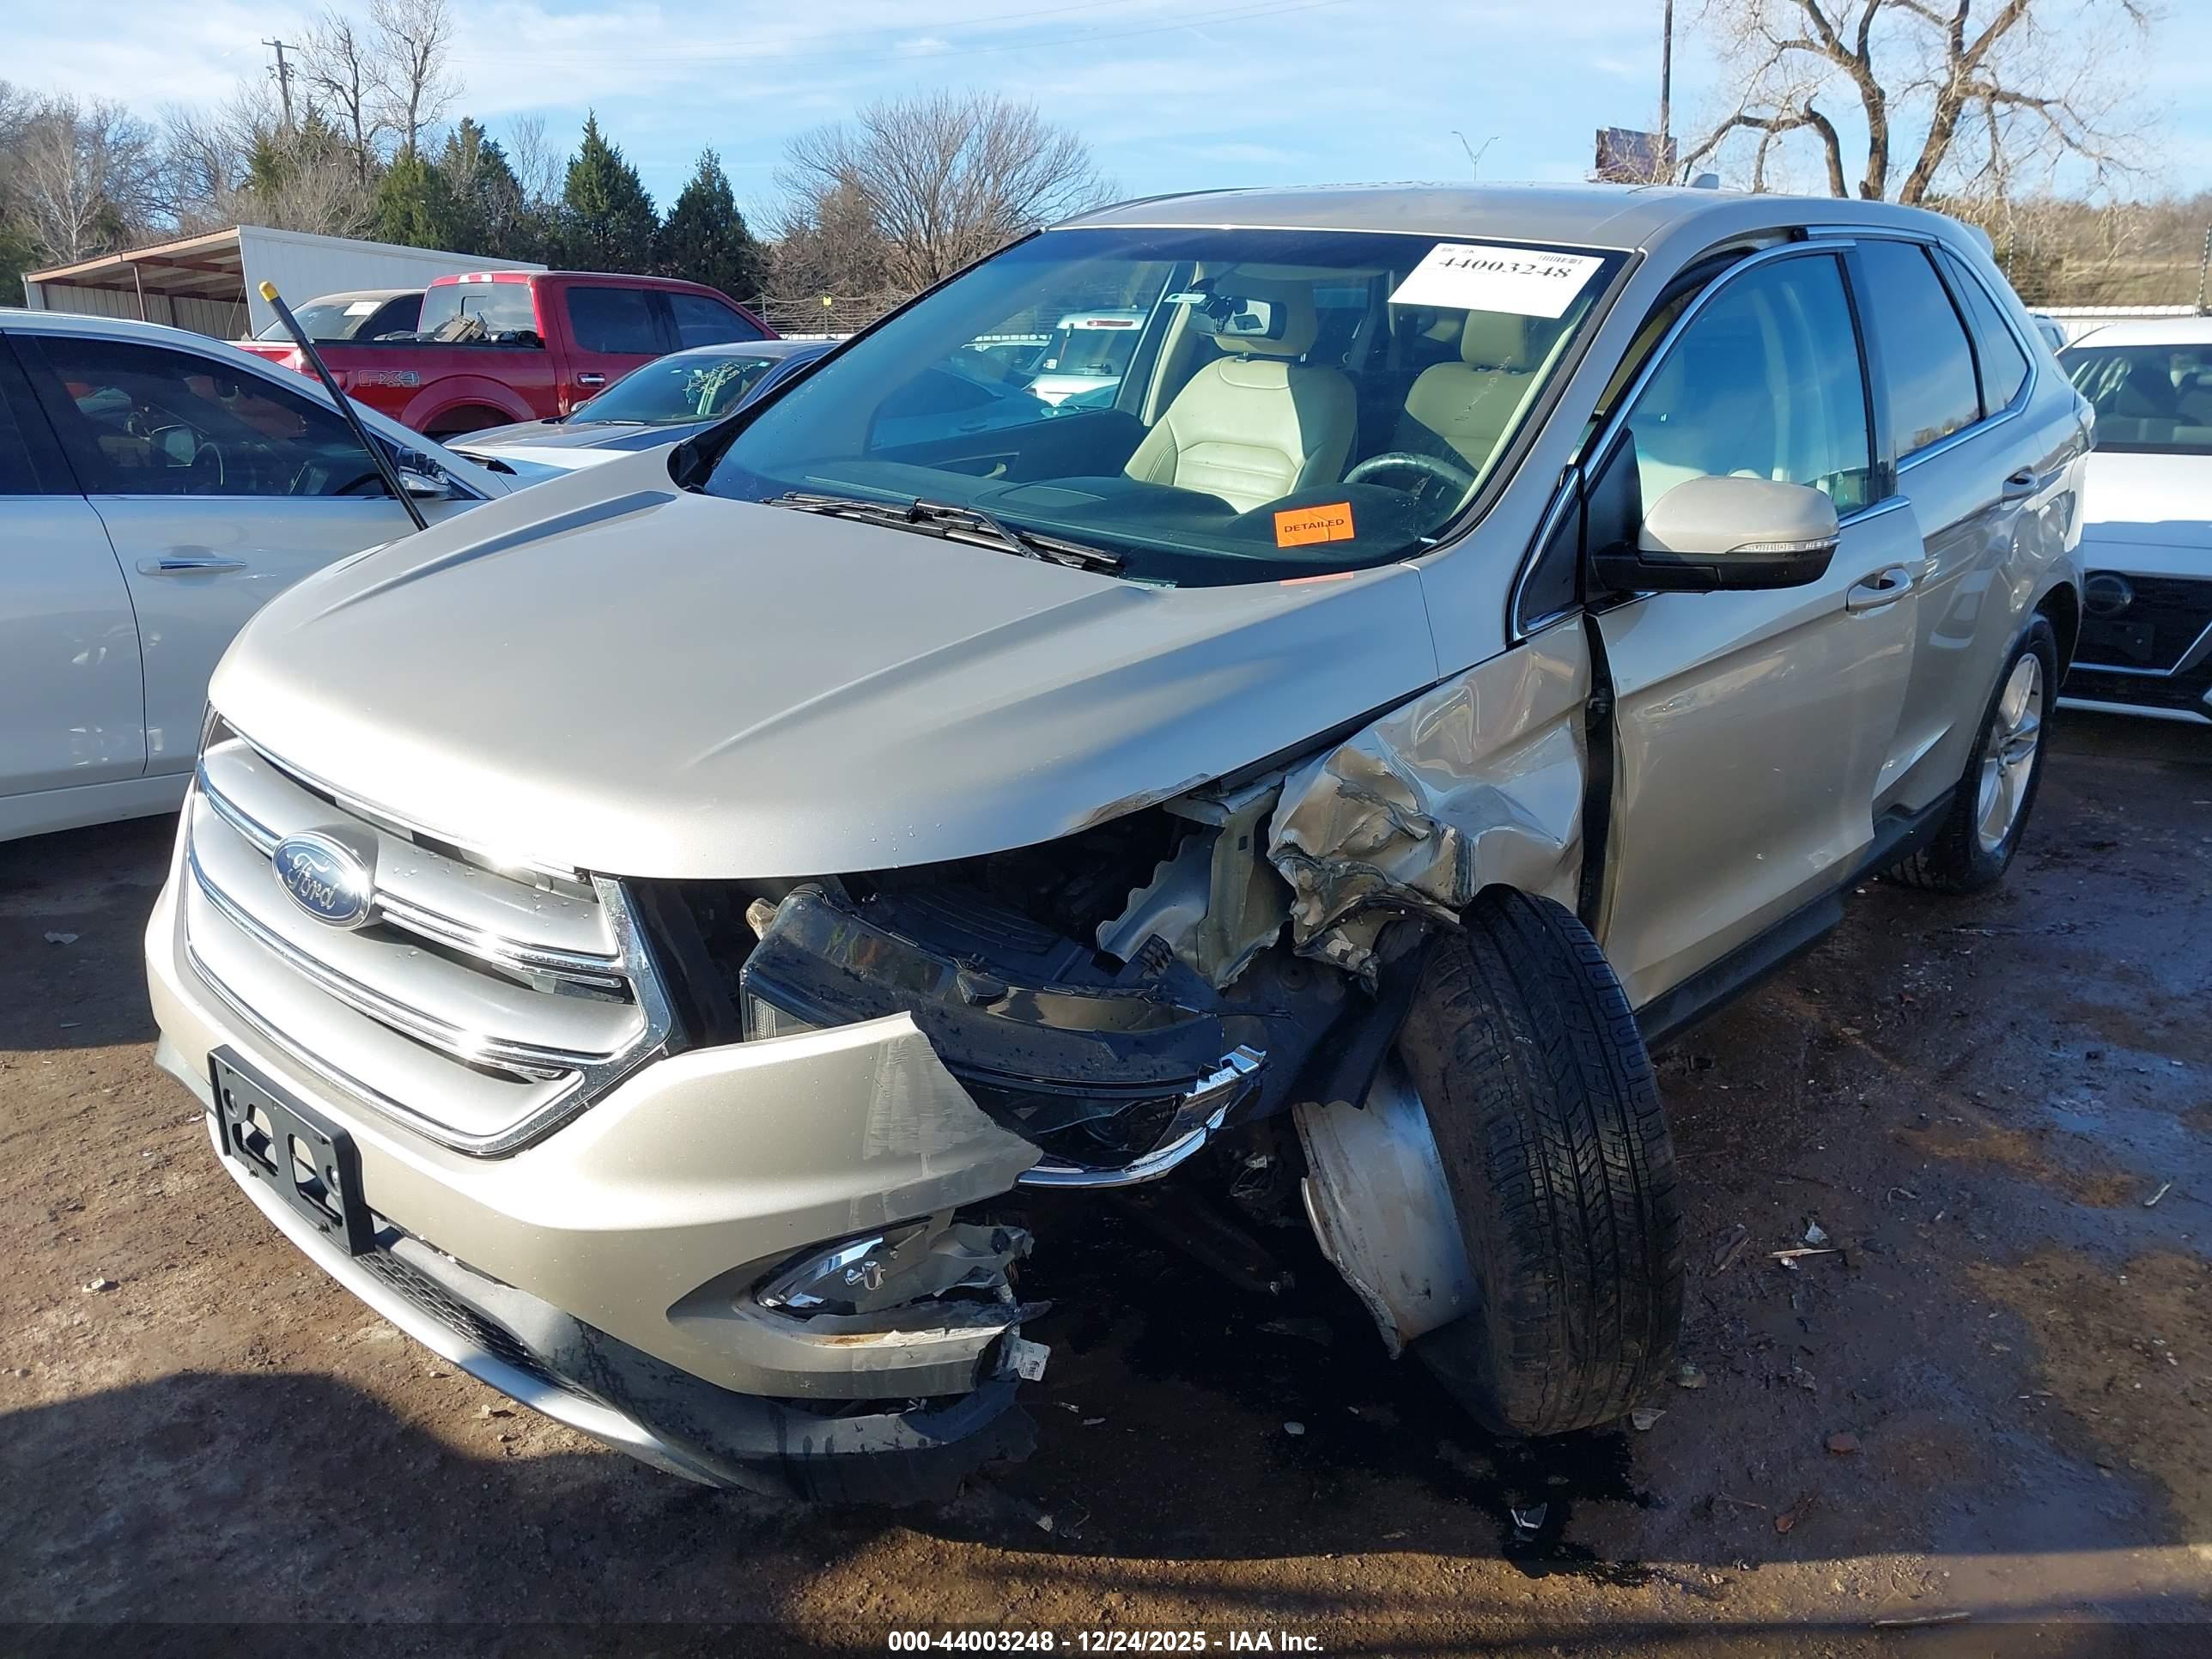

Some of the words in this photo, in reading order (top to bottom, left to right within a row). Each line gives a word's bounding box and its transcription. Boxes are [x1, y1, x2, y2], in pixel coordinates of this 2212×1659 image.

[1439, 256, 1572, 279] 44003248
[359, 370, 420, 386] FX4
[1284, 519, 1345, 533] DETAILED
[286, 853, 339, 910] Ford
